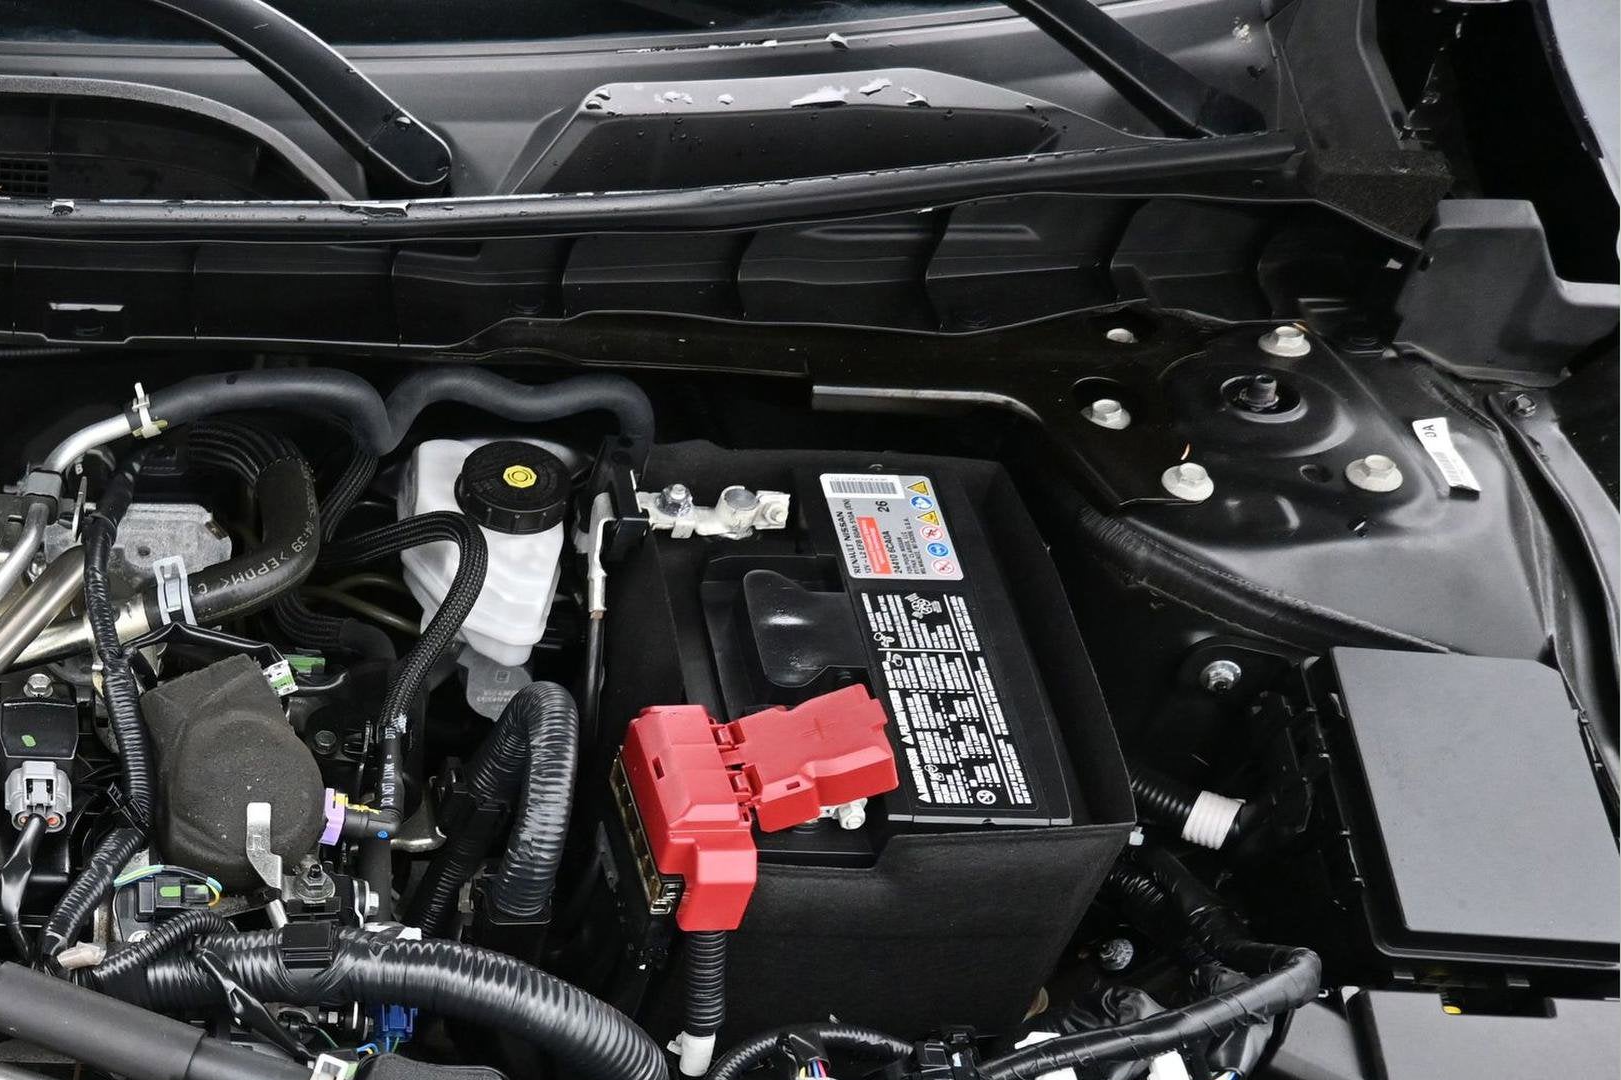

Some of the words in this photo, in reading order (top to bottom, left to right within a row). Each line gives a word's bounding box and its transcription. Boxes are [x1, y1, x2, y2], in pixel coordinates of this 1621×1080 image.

[875, 500, 890, 512] 26
[835, 511, 850, 540] NISSAN
[846, 542, 861, 573] RENAULT
[889, 554, 902, 573] 24410
